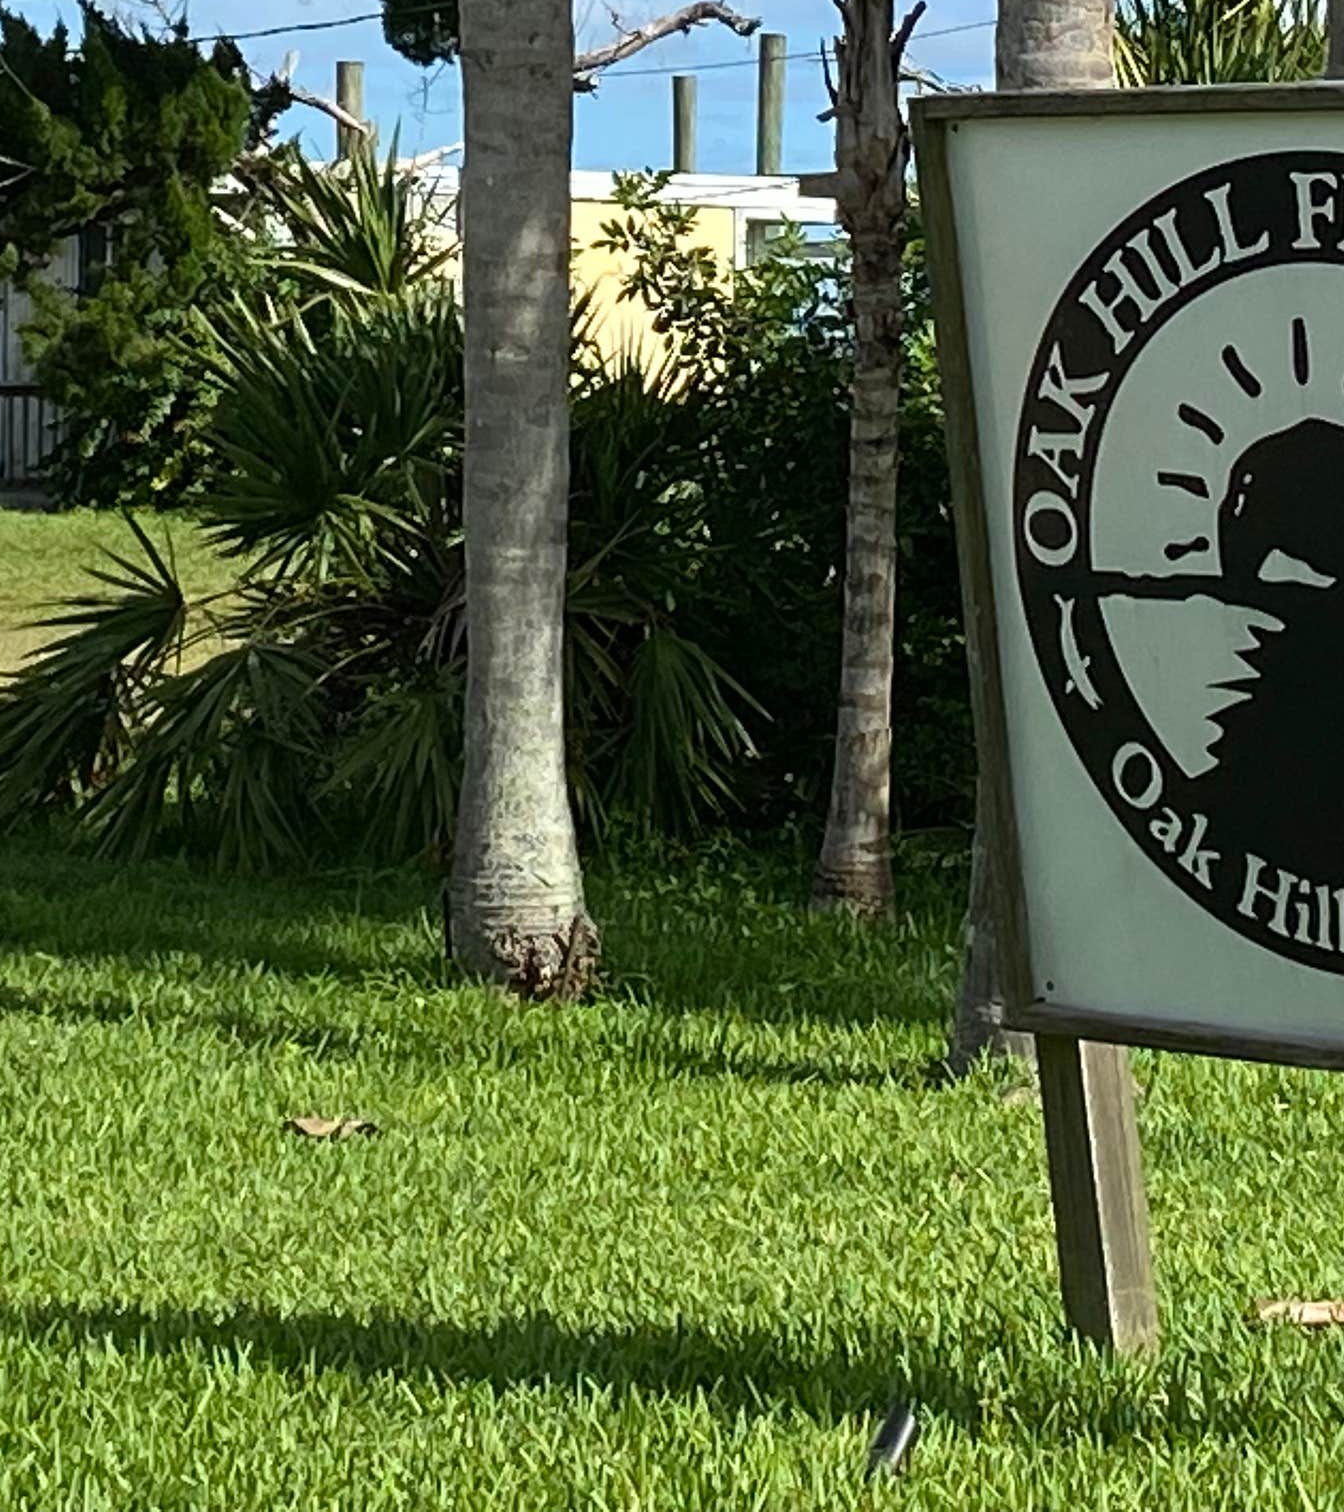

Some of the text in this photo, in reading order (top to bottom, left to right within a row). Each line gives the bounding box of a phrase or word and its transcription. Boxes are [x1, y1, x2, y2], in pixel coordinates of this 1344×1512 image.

[1024, 342, 1109, 566] OAK
[1079, 183, 1269, 354] HILL
[1113, 743, 1220, 889] Oak
